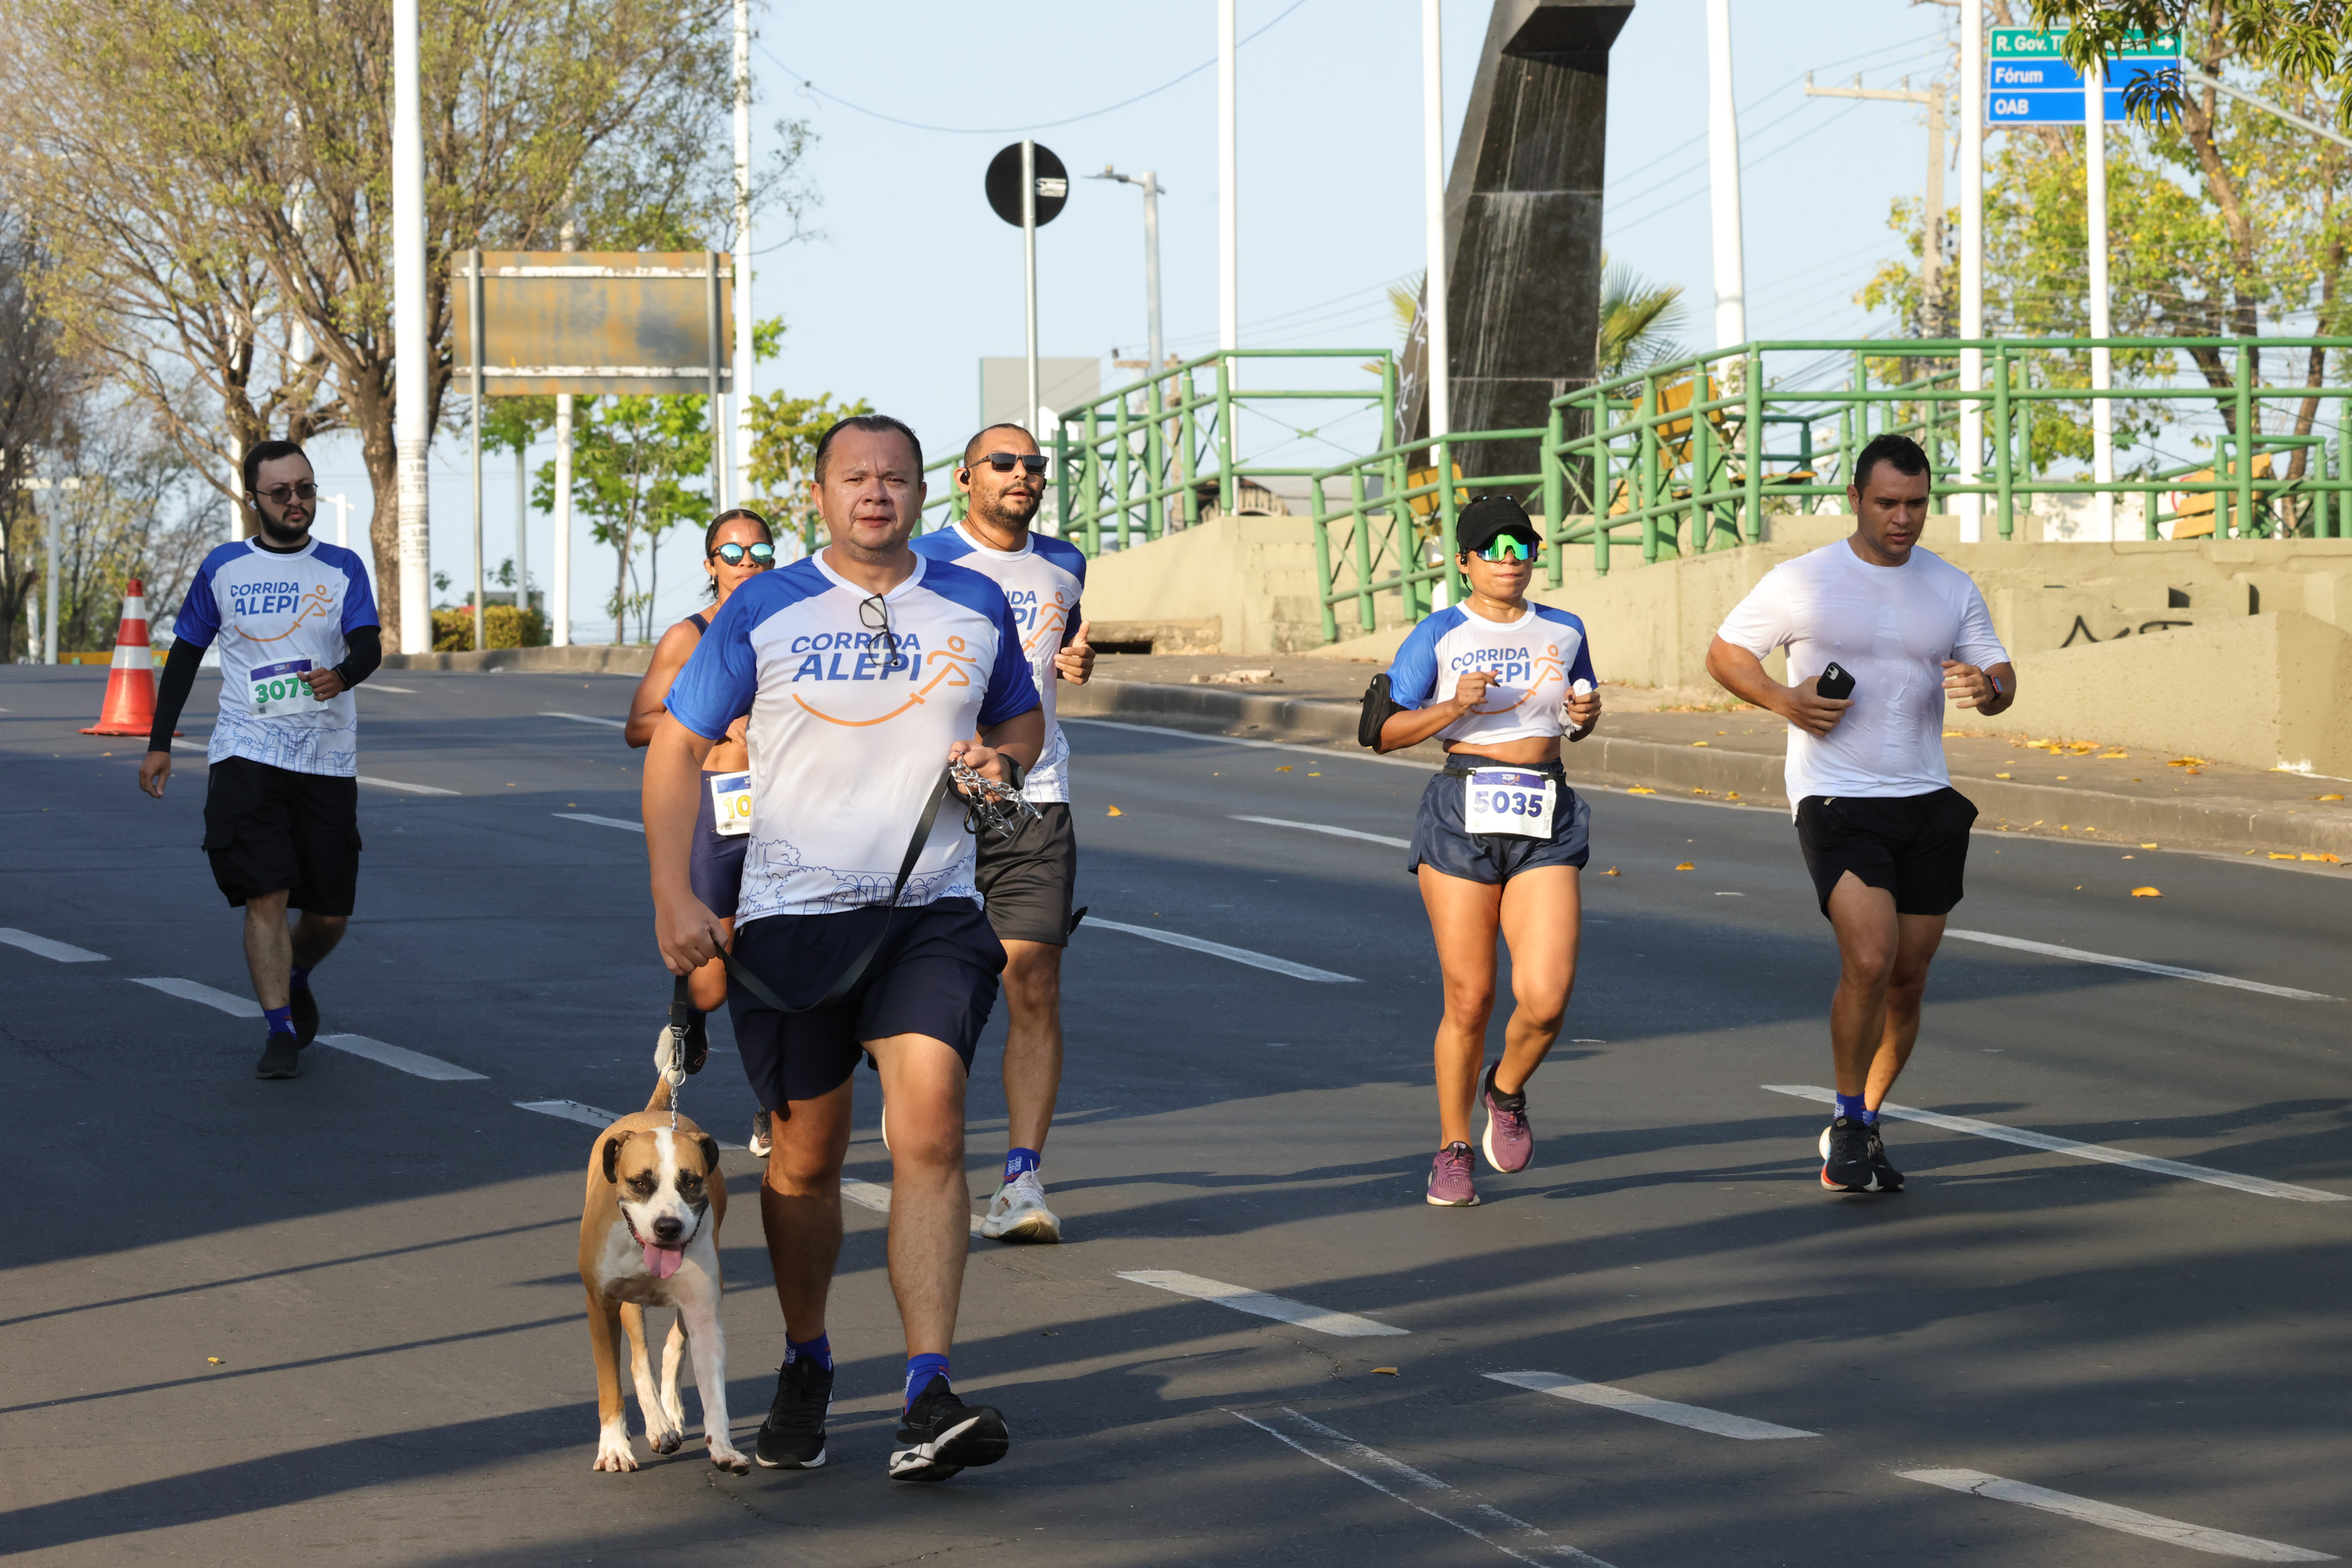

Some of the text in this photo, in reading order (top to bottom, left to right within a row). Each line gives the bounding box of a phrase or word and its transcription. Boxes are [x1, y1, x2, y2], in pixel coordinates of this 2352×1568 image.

[1995, 35, 2012, 52] R.
[2014, 34, 2047, 52] Gov.
[1994, 66, 2043, 83] Fórum
[1994, 98, 2029, 114] OAB
[230, 582, 299, 597] CORRIDA
[234, 595, 299, 618] ALEPI
[791, 632, 920, 654] CORRIDA
[792, 652, 922, 682] ALEPI
[1451, 647, 1530, 671] CORRIDA
[1461, 661, 1530, 684] EPI
[255, 677, 314, 703] 3079
[1473, 790, 1543, 818] 5035
